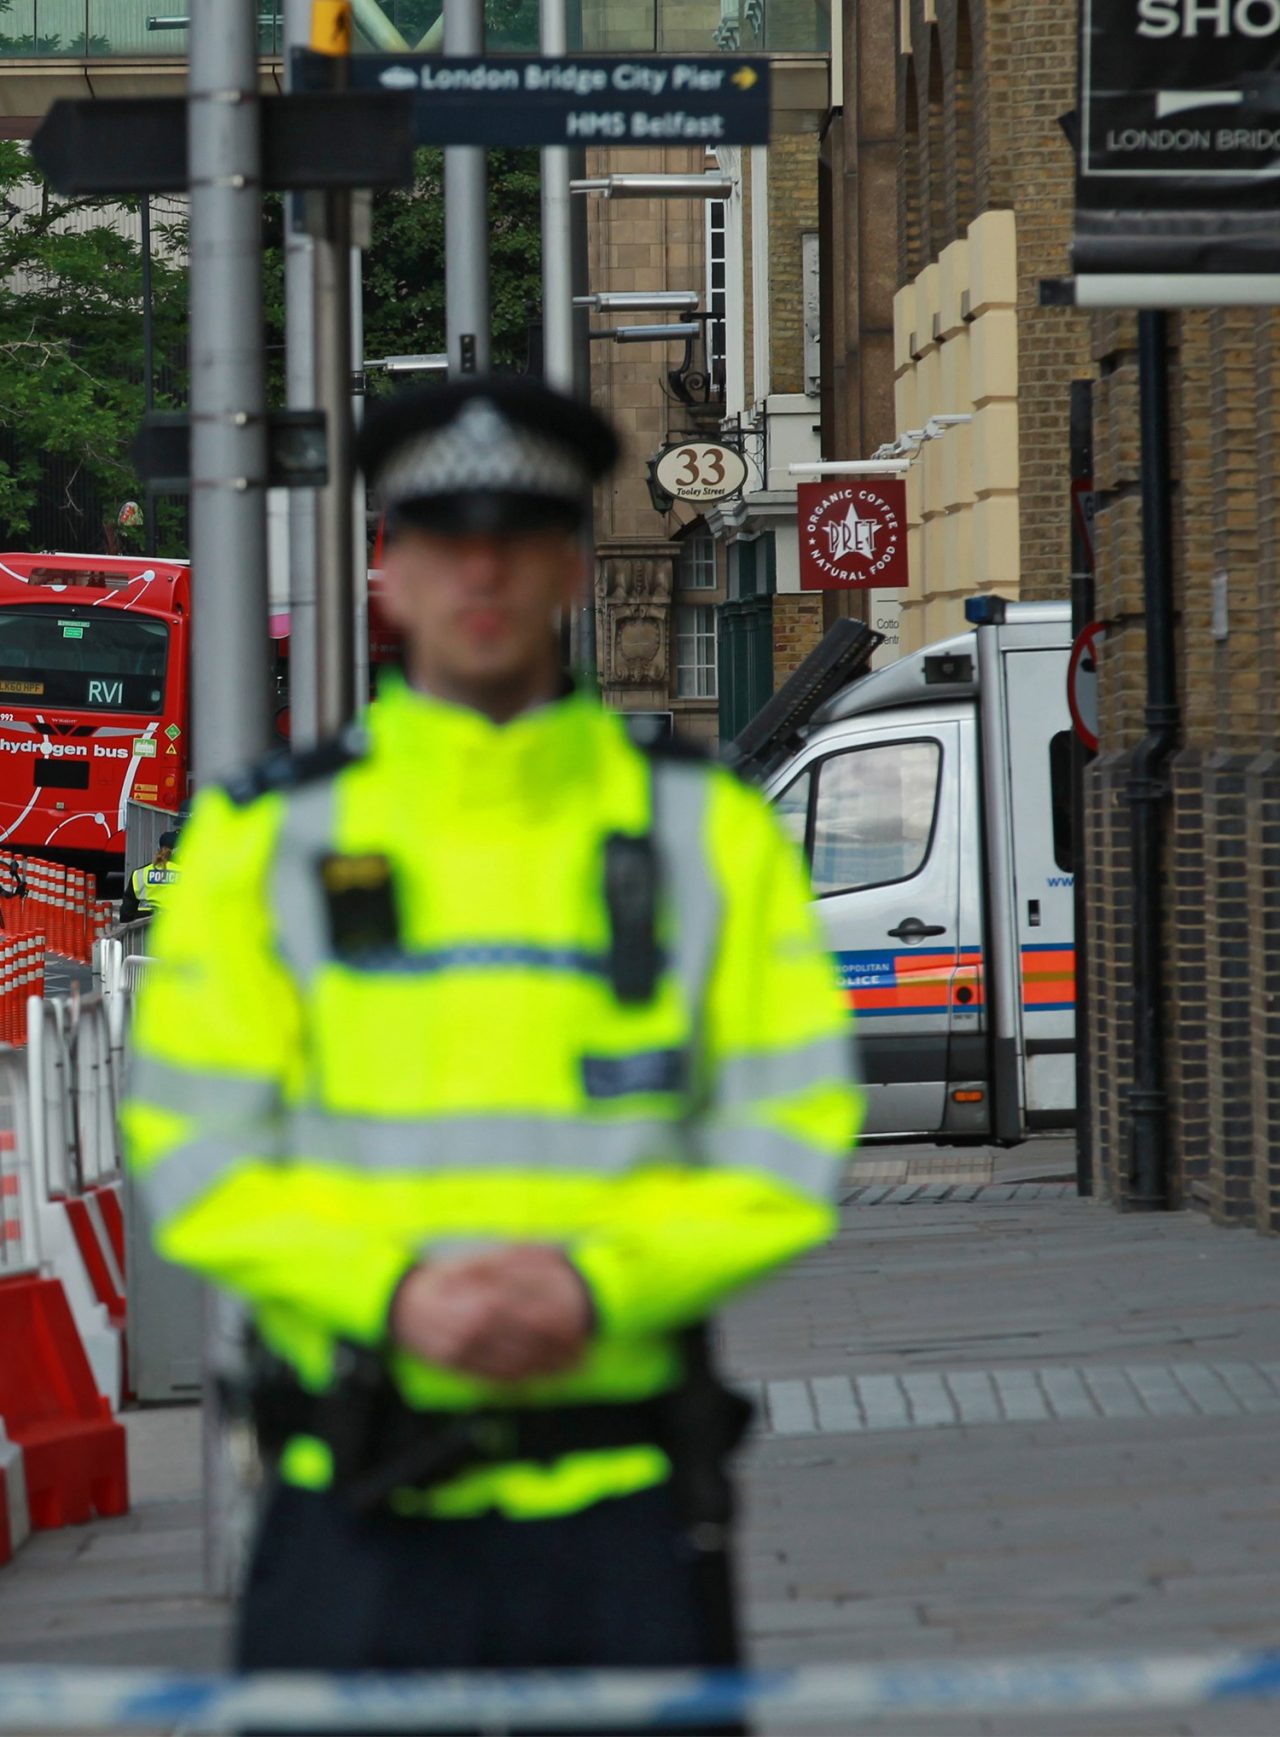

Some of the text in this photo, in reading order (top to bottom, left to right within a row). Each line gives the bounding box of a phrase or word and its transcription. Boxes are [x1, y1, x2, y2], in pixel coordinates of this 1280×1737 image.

[1135, 0, 1280, 37] SHO
[421, 64, 726, 95] London Bridge City Pier
[566, 111, 725, 138] HMS Belfast
[1107, 128, 1211, 150] LONDON
[676, 448, 725, 486] 33
[677, 487, 725, 496] Tooley Street
[807, 489, 898, 532] ORGANIC COFFEE
[829, 519, 877, 553] PRET
[811, 546, 896, 580] NATURAL FOOD
[0, 739, 87, 756] hydrogen
[94, 744, 129, 758] bus
[149, 871, 179, 882] POLIC
[835, 975, 881, 986] OLICE
